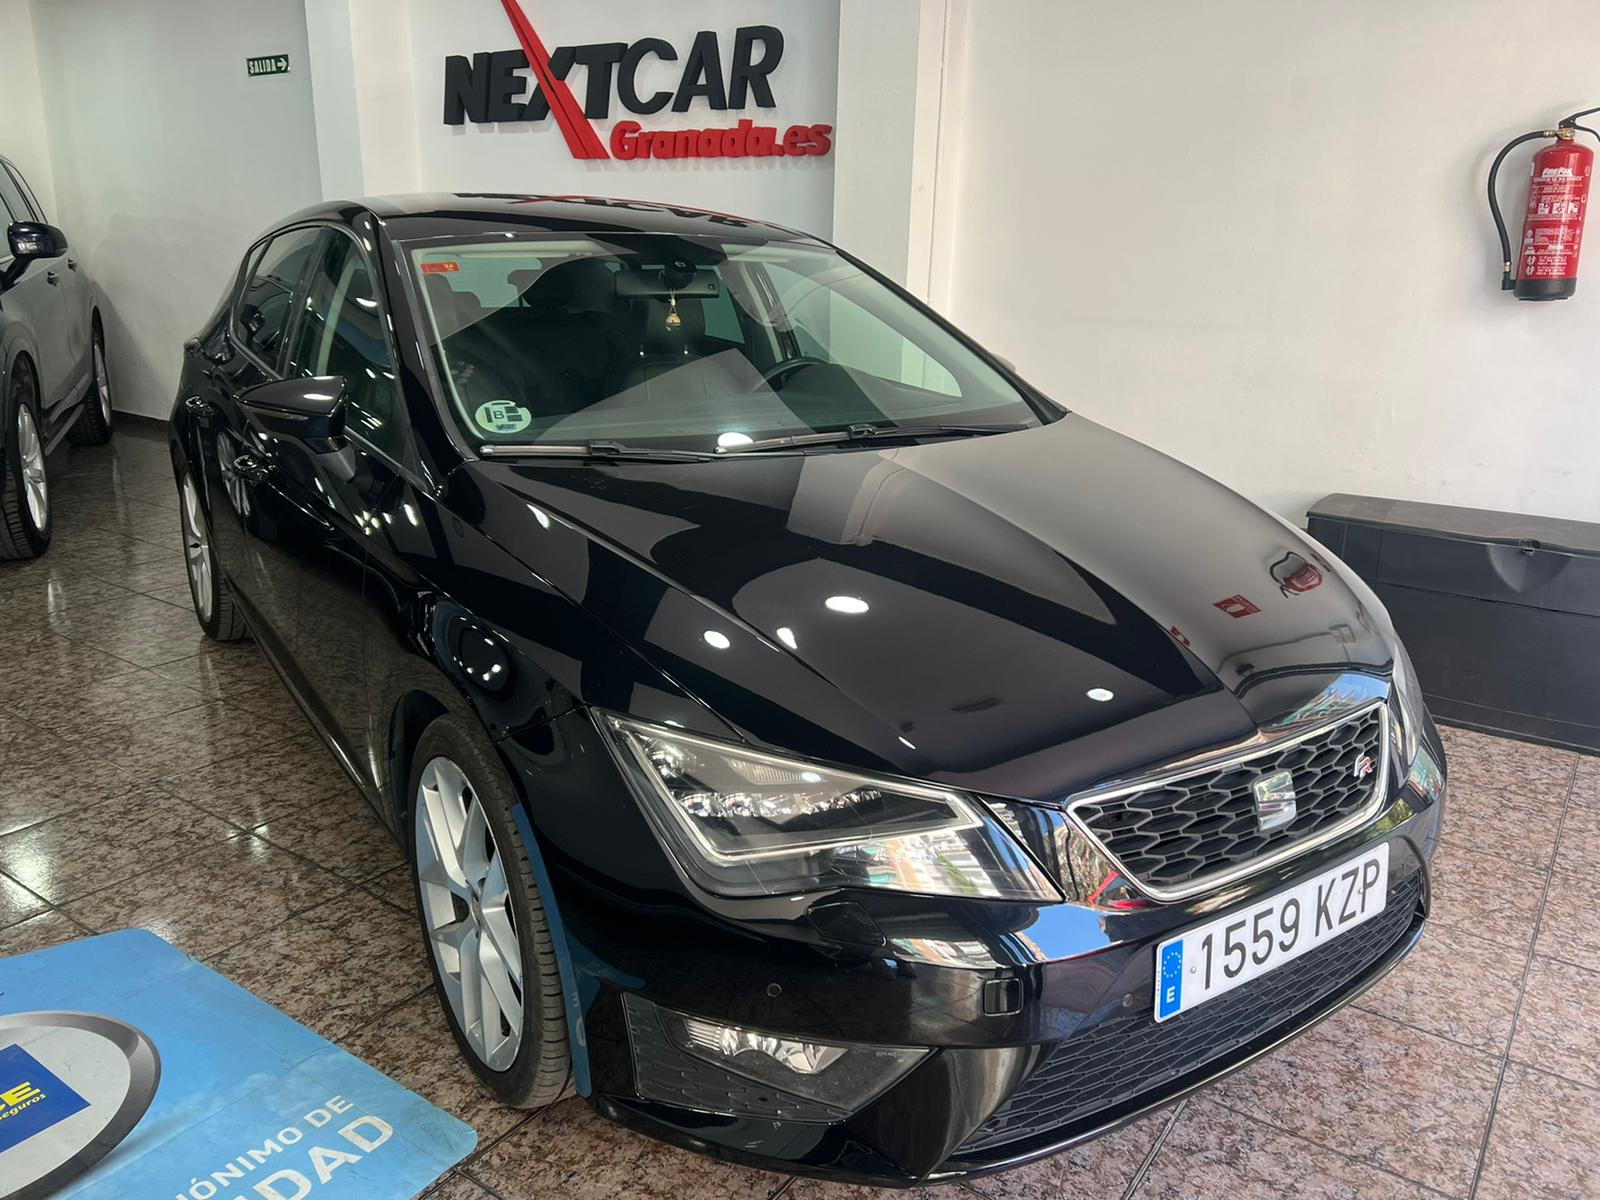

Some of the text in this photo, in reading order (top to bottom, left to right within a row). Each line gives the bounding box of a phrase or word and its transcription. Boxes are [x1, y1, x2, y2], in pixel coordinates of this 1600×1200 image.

[248, 58, 277, 74] SALIDA
[444, 25, 784, 125] NEXTCAR
[610, 119, 833, 160] Granada.es
[493, 410, 504, 419] B
[1202, 859, 1381, 990] 1559 KZP
[1166, 986, 1176, 1003] E
[0, 1081, 41, 1112] E
[0, 1093, 47, 1120] eguros
[175, 1095, 354, 1200] ÓNIMO DE
[232, 1115, 394, 1200] DAD
